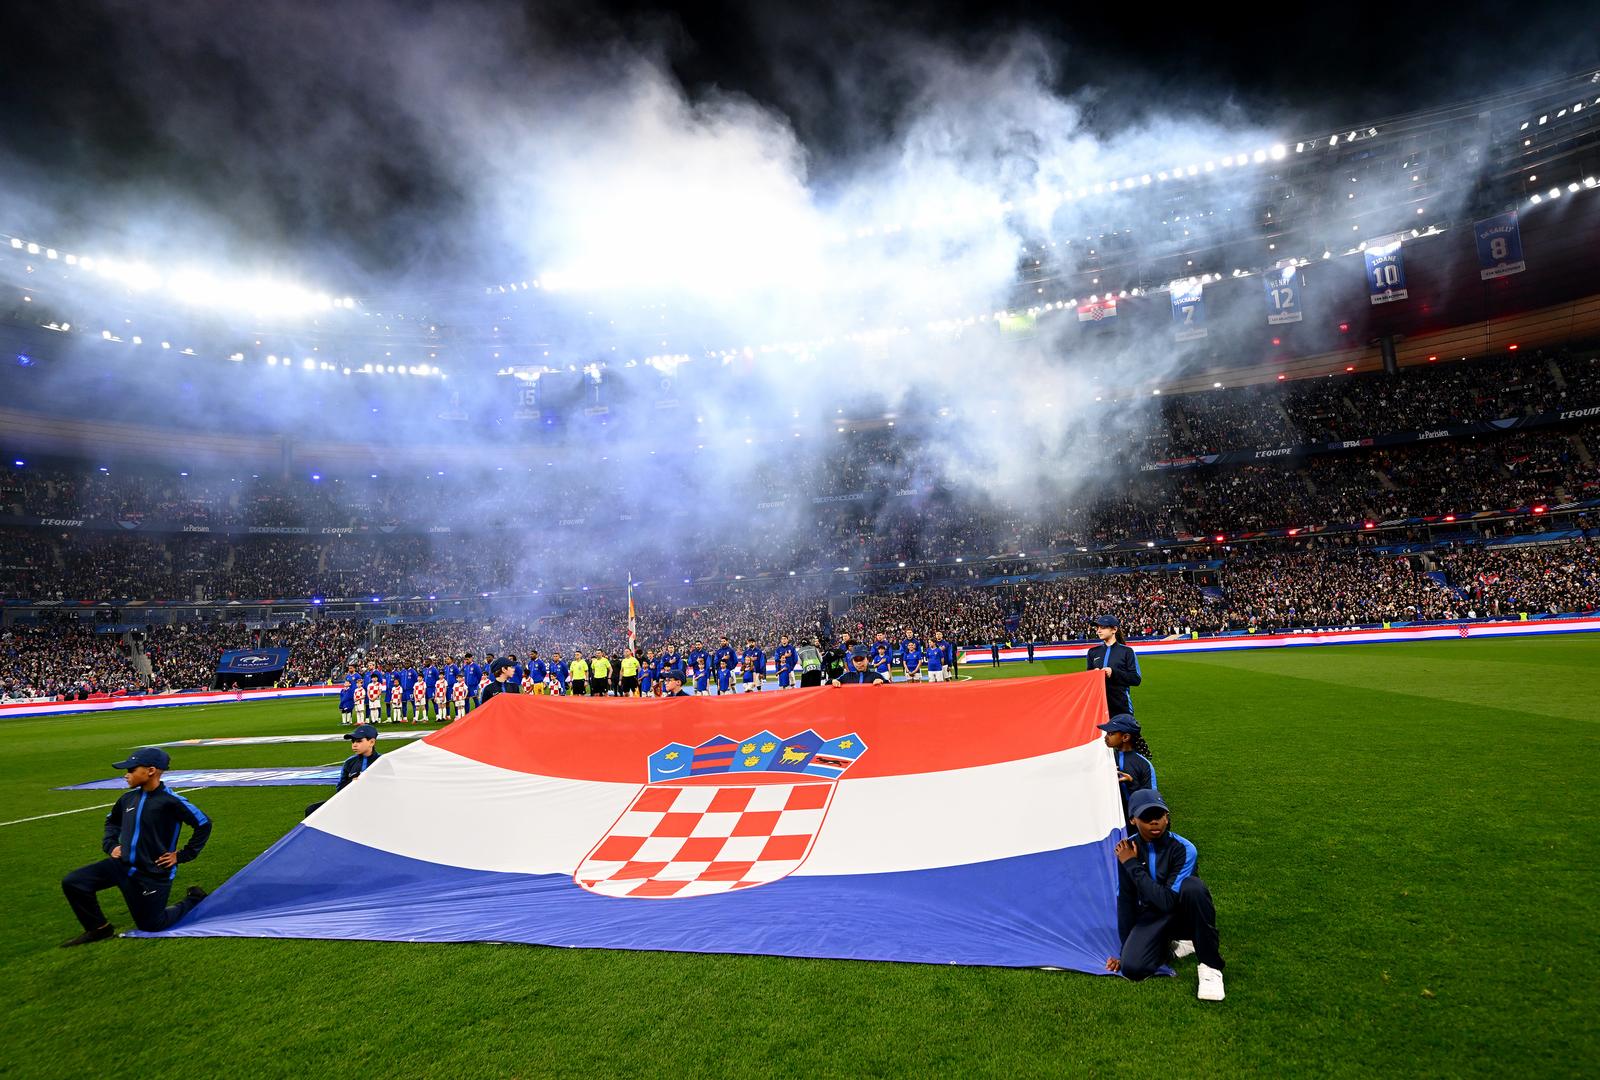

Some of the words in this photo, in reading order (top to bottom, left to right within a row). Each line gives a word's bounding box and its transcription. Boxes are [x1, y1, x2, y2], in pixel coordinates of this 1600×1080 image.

[1490, 237, 1507, 260] 8
[1372, 255, 1397, 266] ZIDANE
[1373, 264, 1399, 288] 10
[1271, 287, 1295, 309] 12
[1181, 305, 1195, 325] 7
[518, 389, 536, 406] 15
[1425, 429, 1449, 438] Parisien
